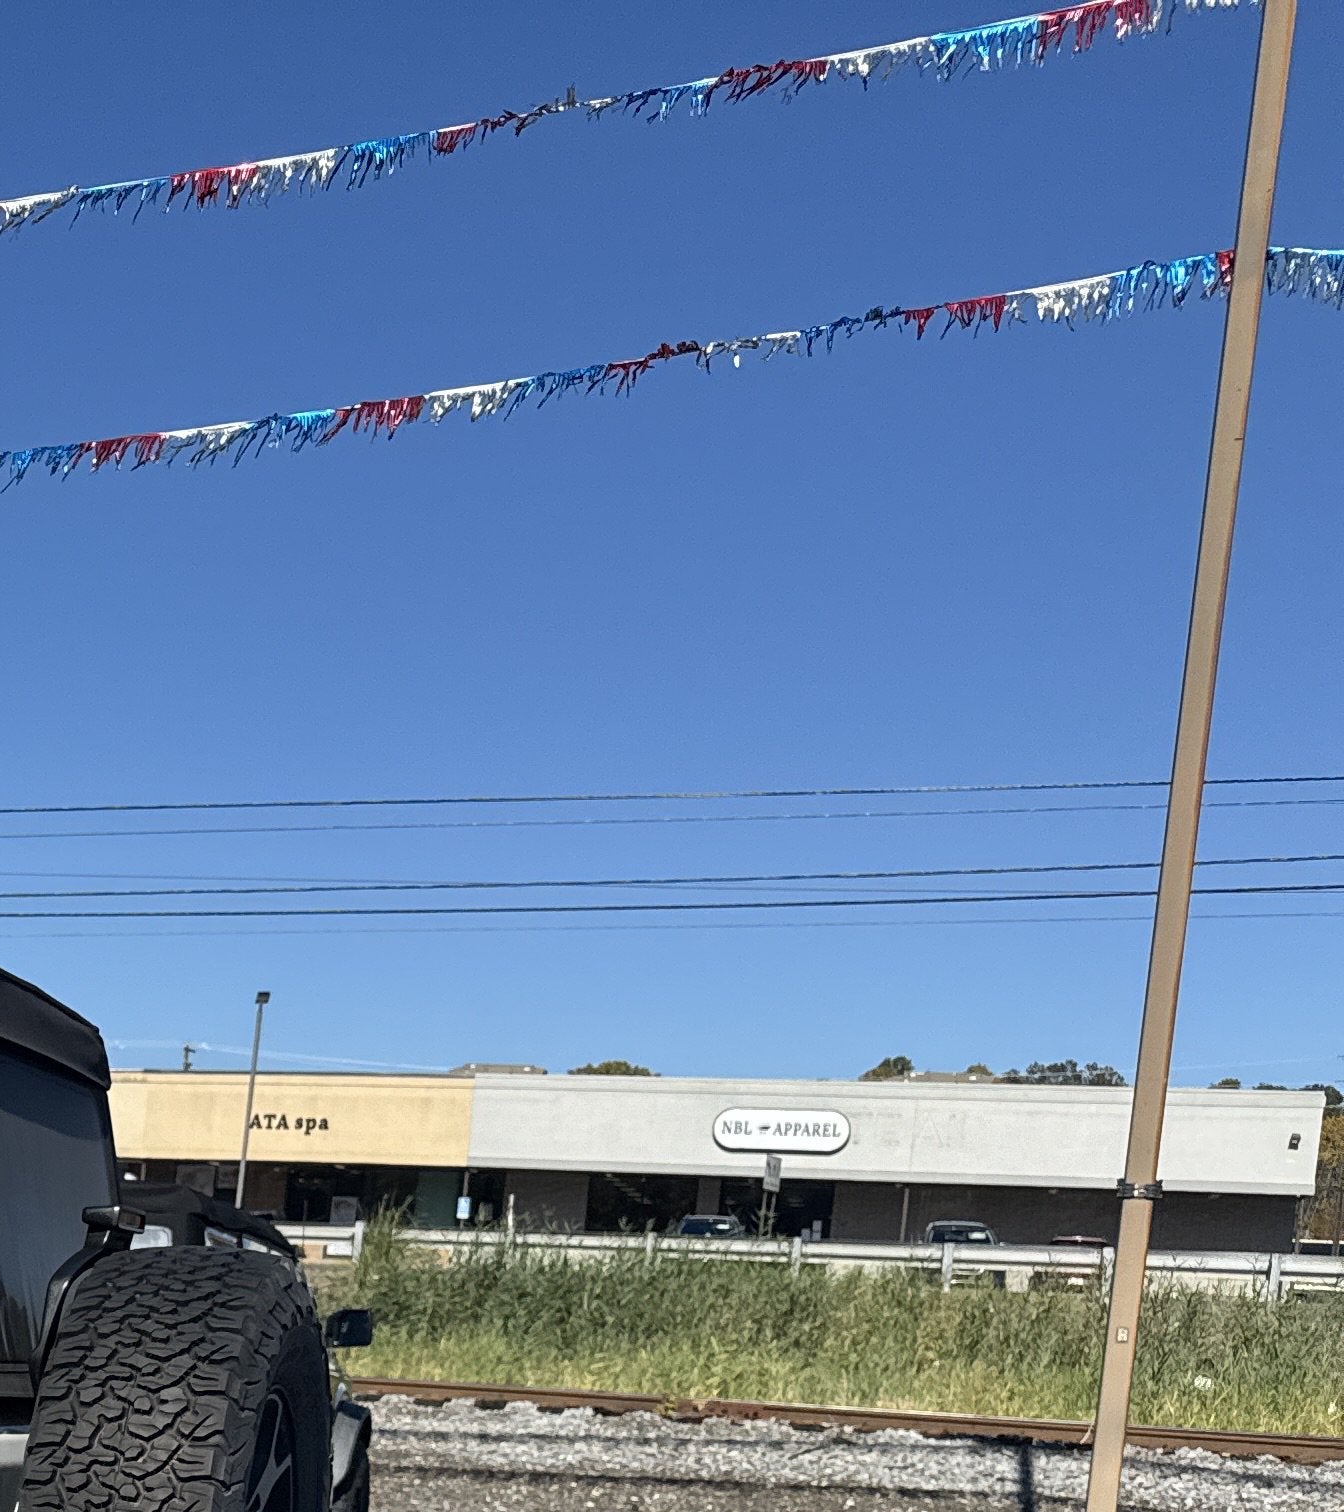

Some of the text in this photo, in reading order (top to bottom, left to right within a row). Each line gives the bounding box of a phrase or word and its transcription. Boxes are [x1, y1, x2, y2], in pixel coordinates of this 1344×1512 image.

[248, 1113, 329, 1136] ATA spa
[721, 1120, 842, 1138] NBL APPAREL
